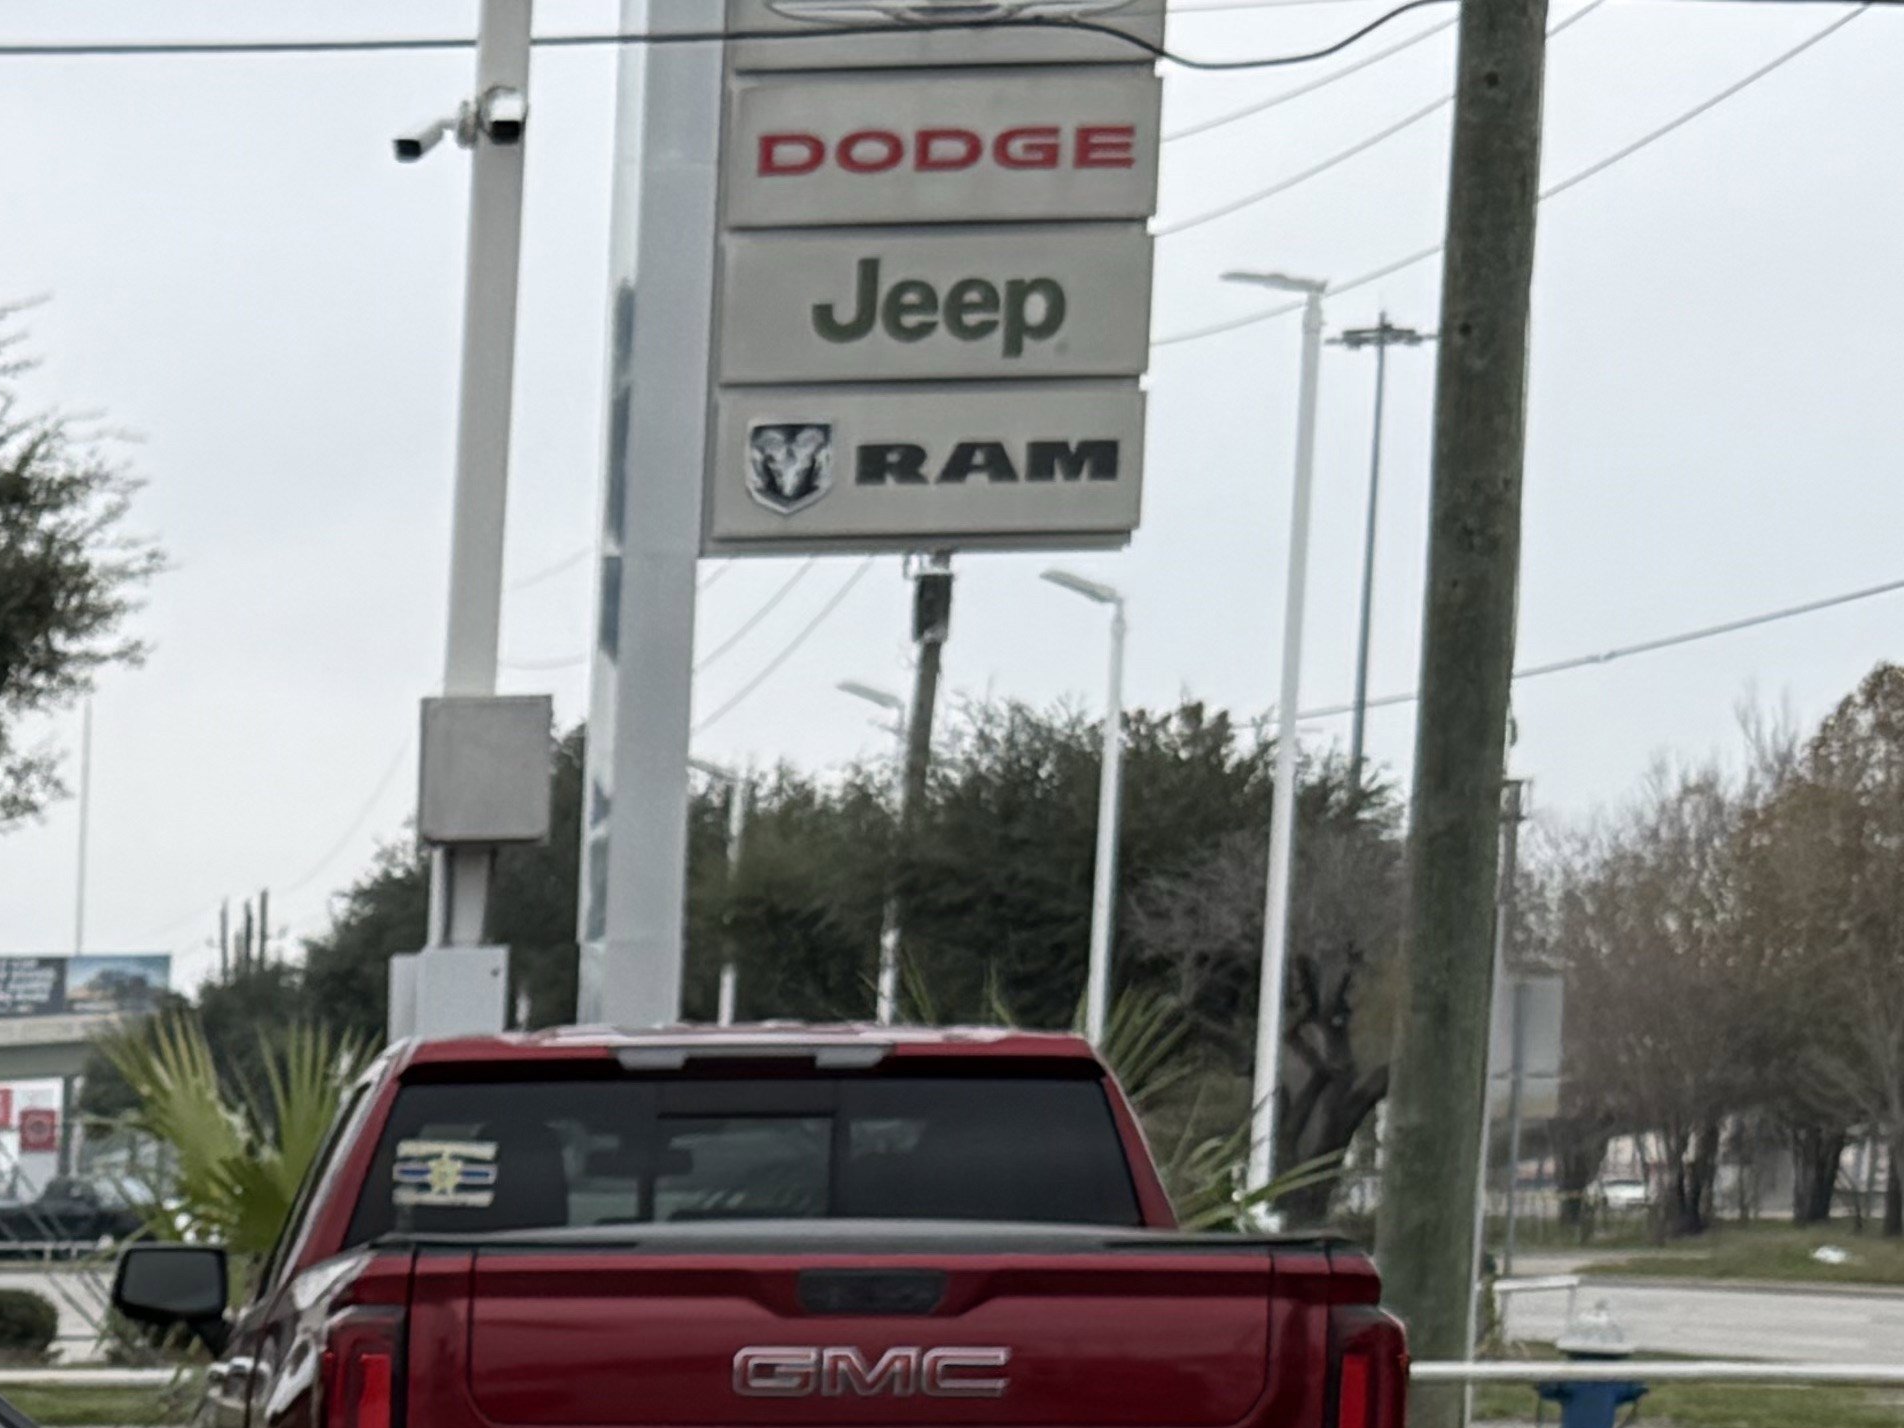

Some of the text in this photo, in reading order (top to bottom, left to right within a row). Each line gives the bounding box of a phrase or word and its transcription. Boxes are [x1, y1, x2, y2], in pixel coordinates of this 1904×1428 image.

[757, 125, 1136, 177] DODGE
[811, 256, 1066, 359] Jeep
[855, 439, 1120, 486] RAM
[732, 1345, 1012, 1398] GMC
